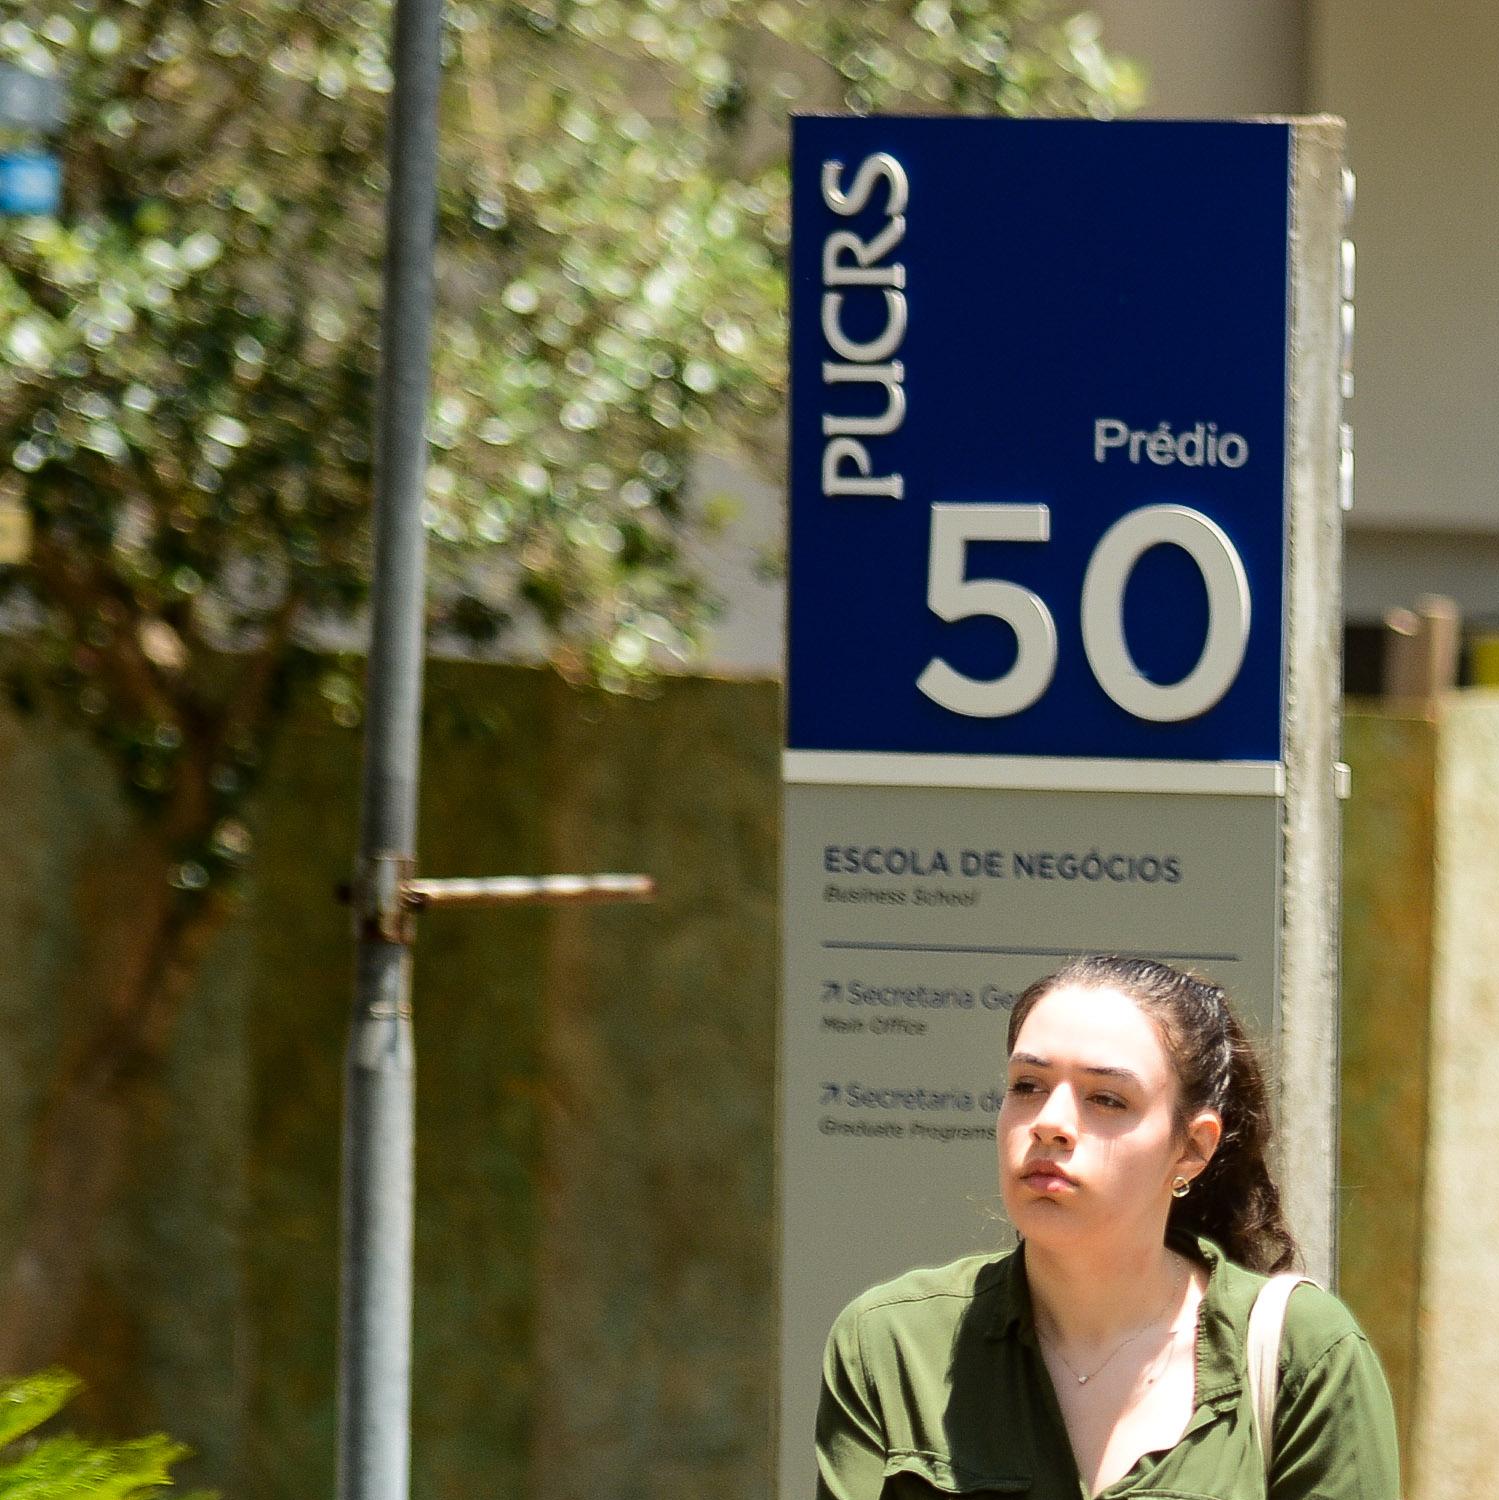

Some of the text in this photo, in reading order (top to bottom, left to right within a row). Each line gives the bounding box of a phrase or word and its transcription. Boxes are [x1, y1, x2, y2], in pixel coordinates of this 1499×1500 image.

[821, 151, 909, 499] PUCRS
[1093, 418, 1249, 469] Prédio
[915, 501, 1252, 723] 50
[824, 845, 1182, 884] ESCOLA DE NEGÓCIOS
[823, 884, 977, 907] Business School
[847, 979, 1018, 1010] Secretaria Ge
[822, 1016, 928, 1036] Main Office
[846, 1081, 975, 1112] Secretaria
